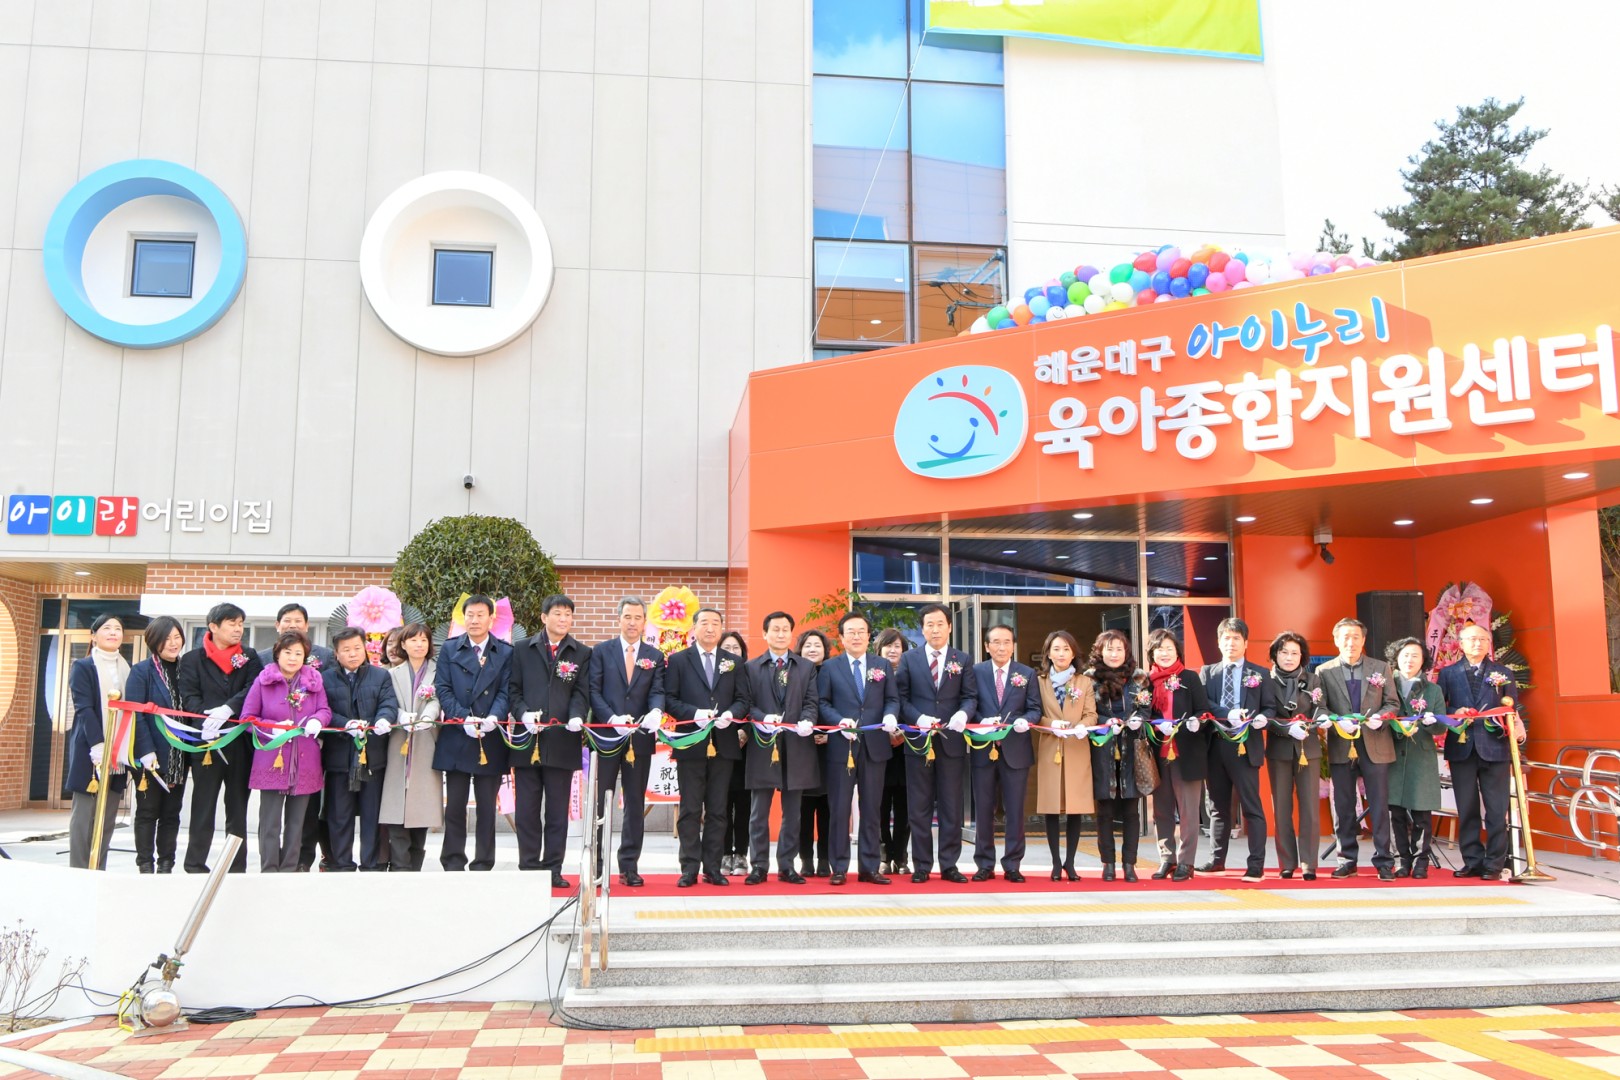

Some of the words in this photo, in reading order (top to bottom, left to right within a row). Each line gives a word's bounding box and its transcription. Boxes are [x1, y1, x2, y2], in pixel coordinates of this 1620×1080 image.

[1033, 335, 1176, 386] 해운대구
[1185, 296, 1390, 365] 아이누리
[1033, 323, 1619, 470] 육아종합지원센터
[9, 498, 137, 535] 아이랑
[142, 498, 272, 535] 어린이집
